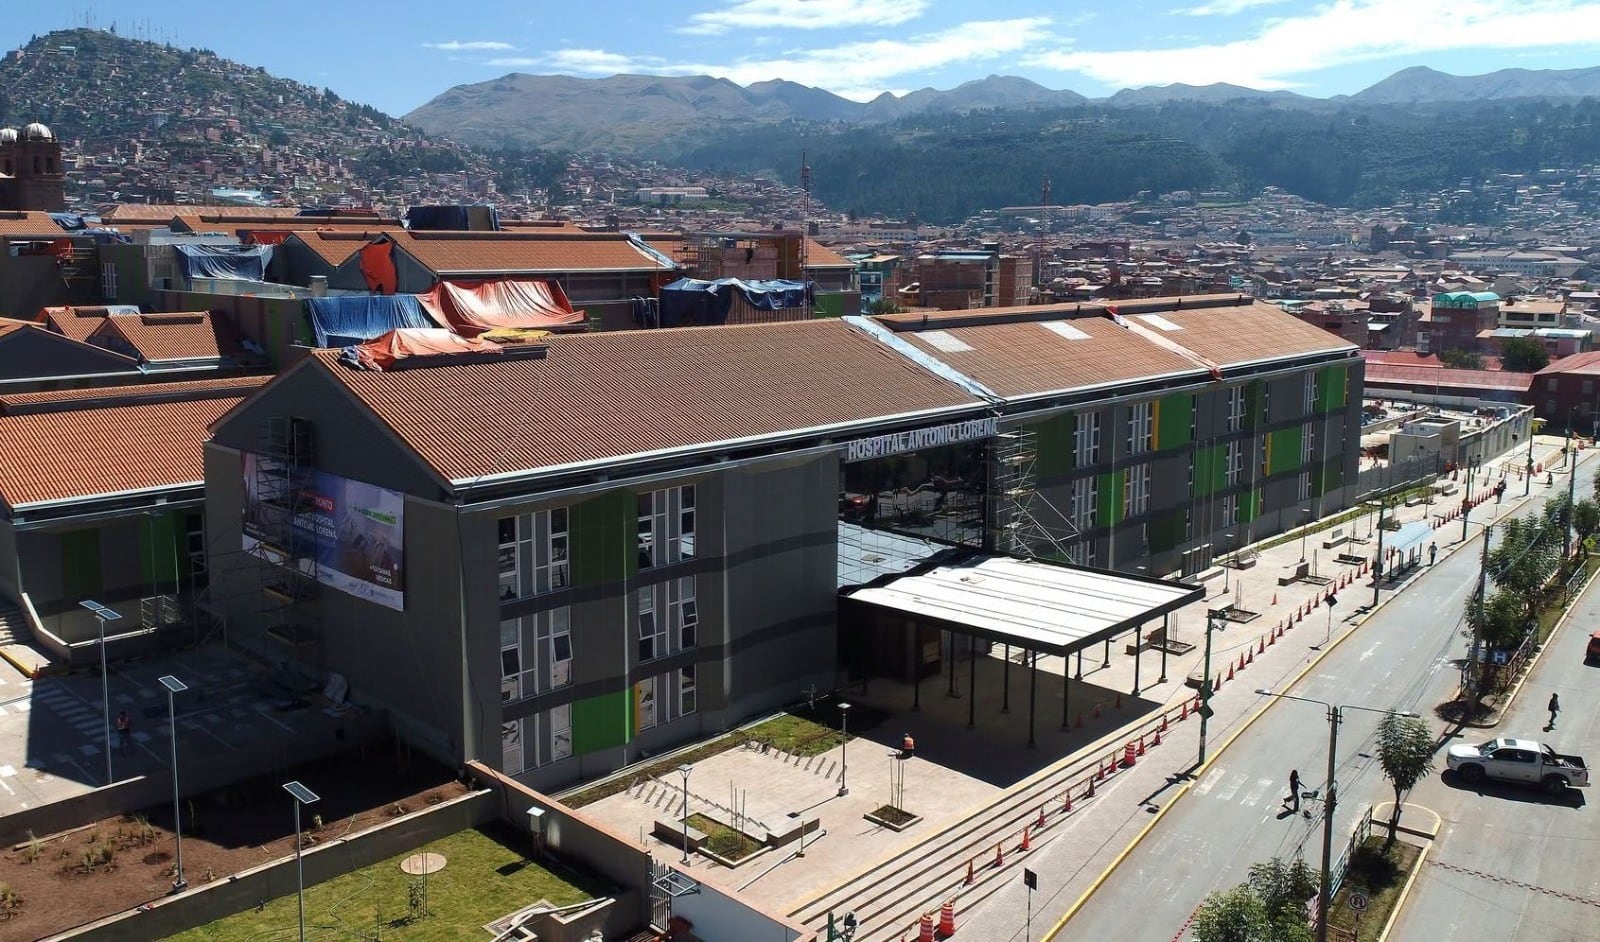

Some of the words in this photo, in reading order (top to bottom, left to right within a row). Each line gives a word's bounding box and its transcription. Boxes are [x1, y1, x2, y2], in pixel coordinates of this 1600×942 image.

[848, 433, 907, 460] HOSPITAL
[907, 423, 957, 448] ANTONIO
[958, 416, 998, 440] LORENA
